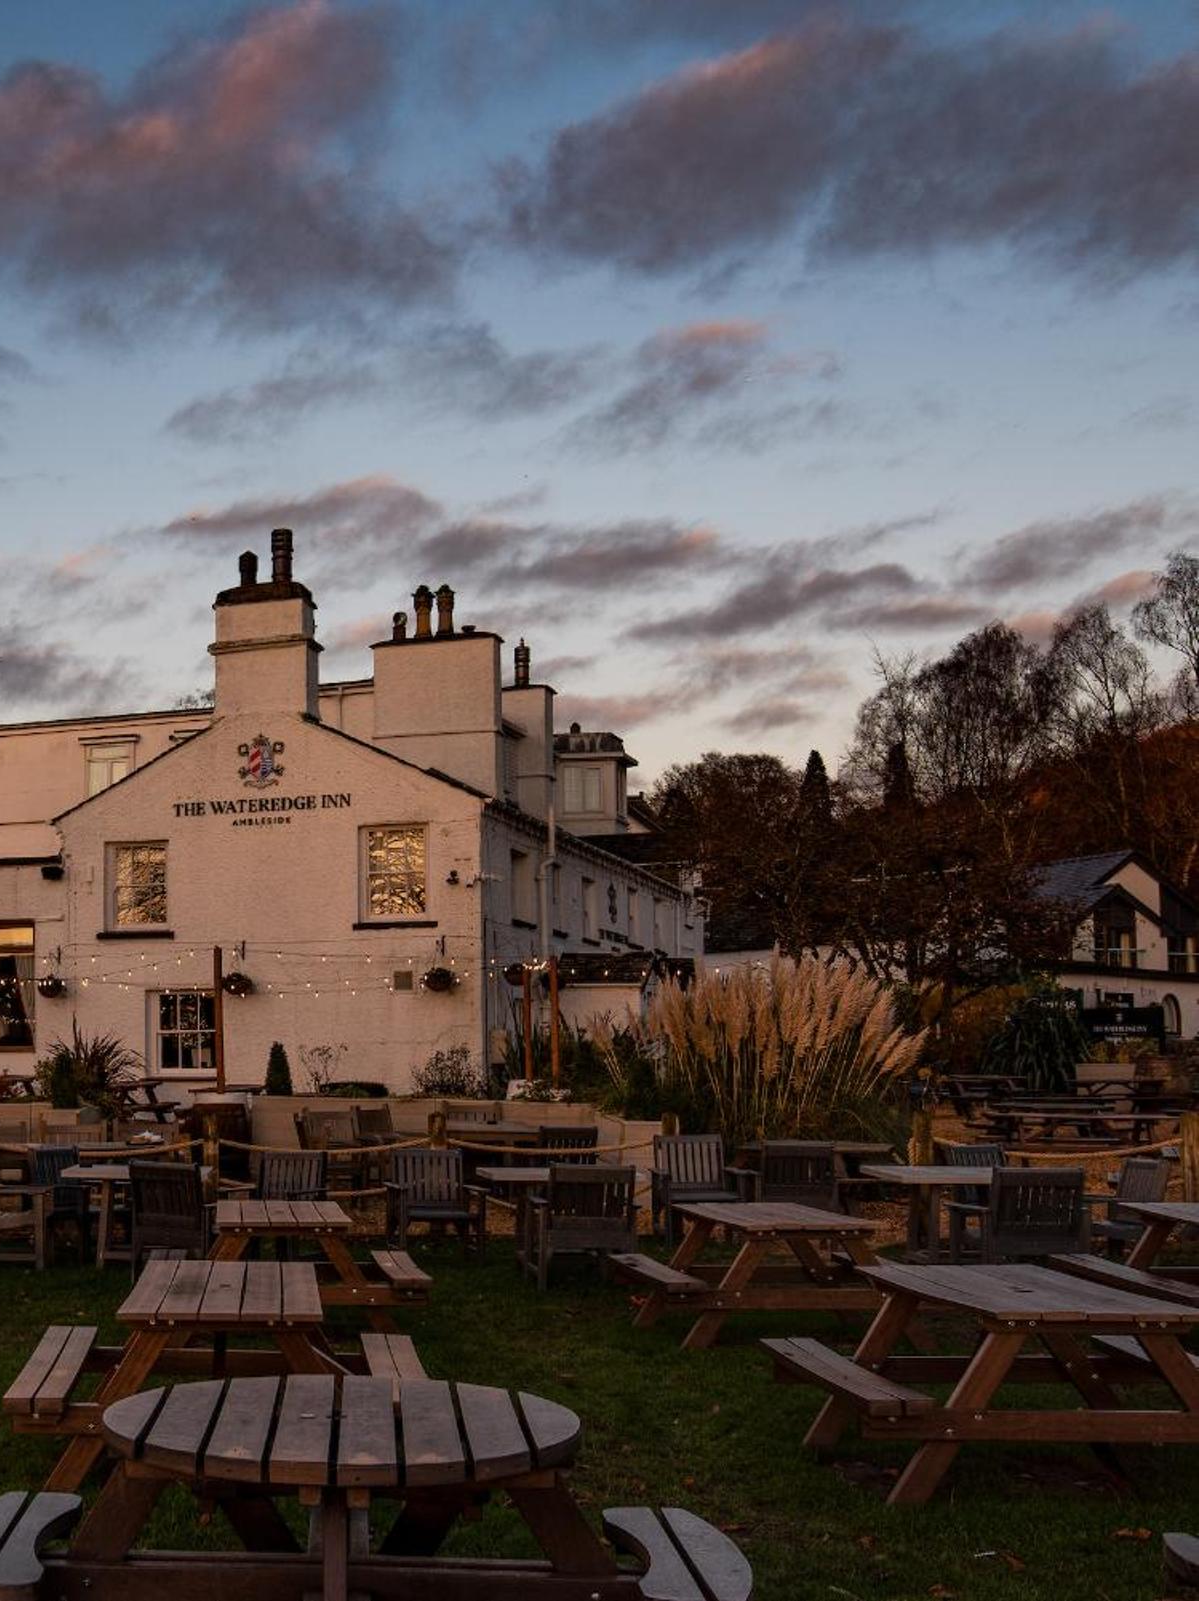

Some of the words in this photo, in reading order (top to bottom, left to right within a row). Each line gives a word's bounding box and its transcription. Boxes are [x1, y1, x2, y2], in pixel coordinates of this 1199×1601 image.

[173, 801, 206, 817] THE
[210, 795, 317, 814] WATEREDGE
[322, 793, 352, 808] INN
[232, 816, 291, 826] AMBLESIDE
